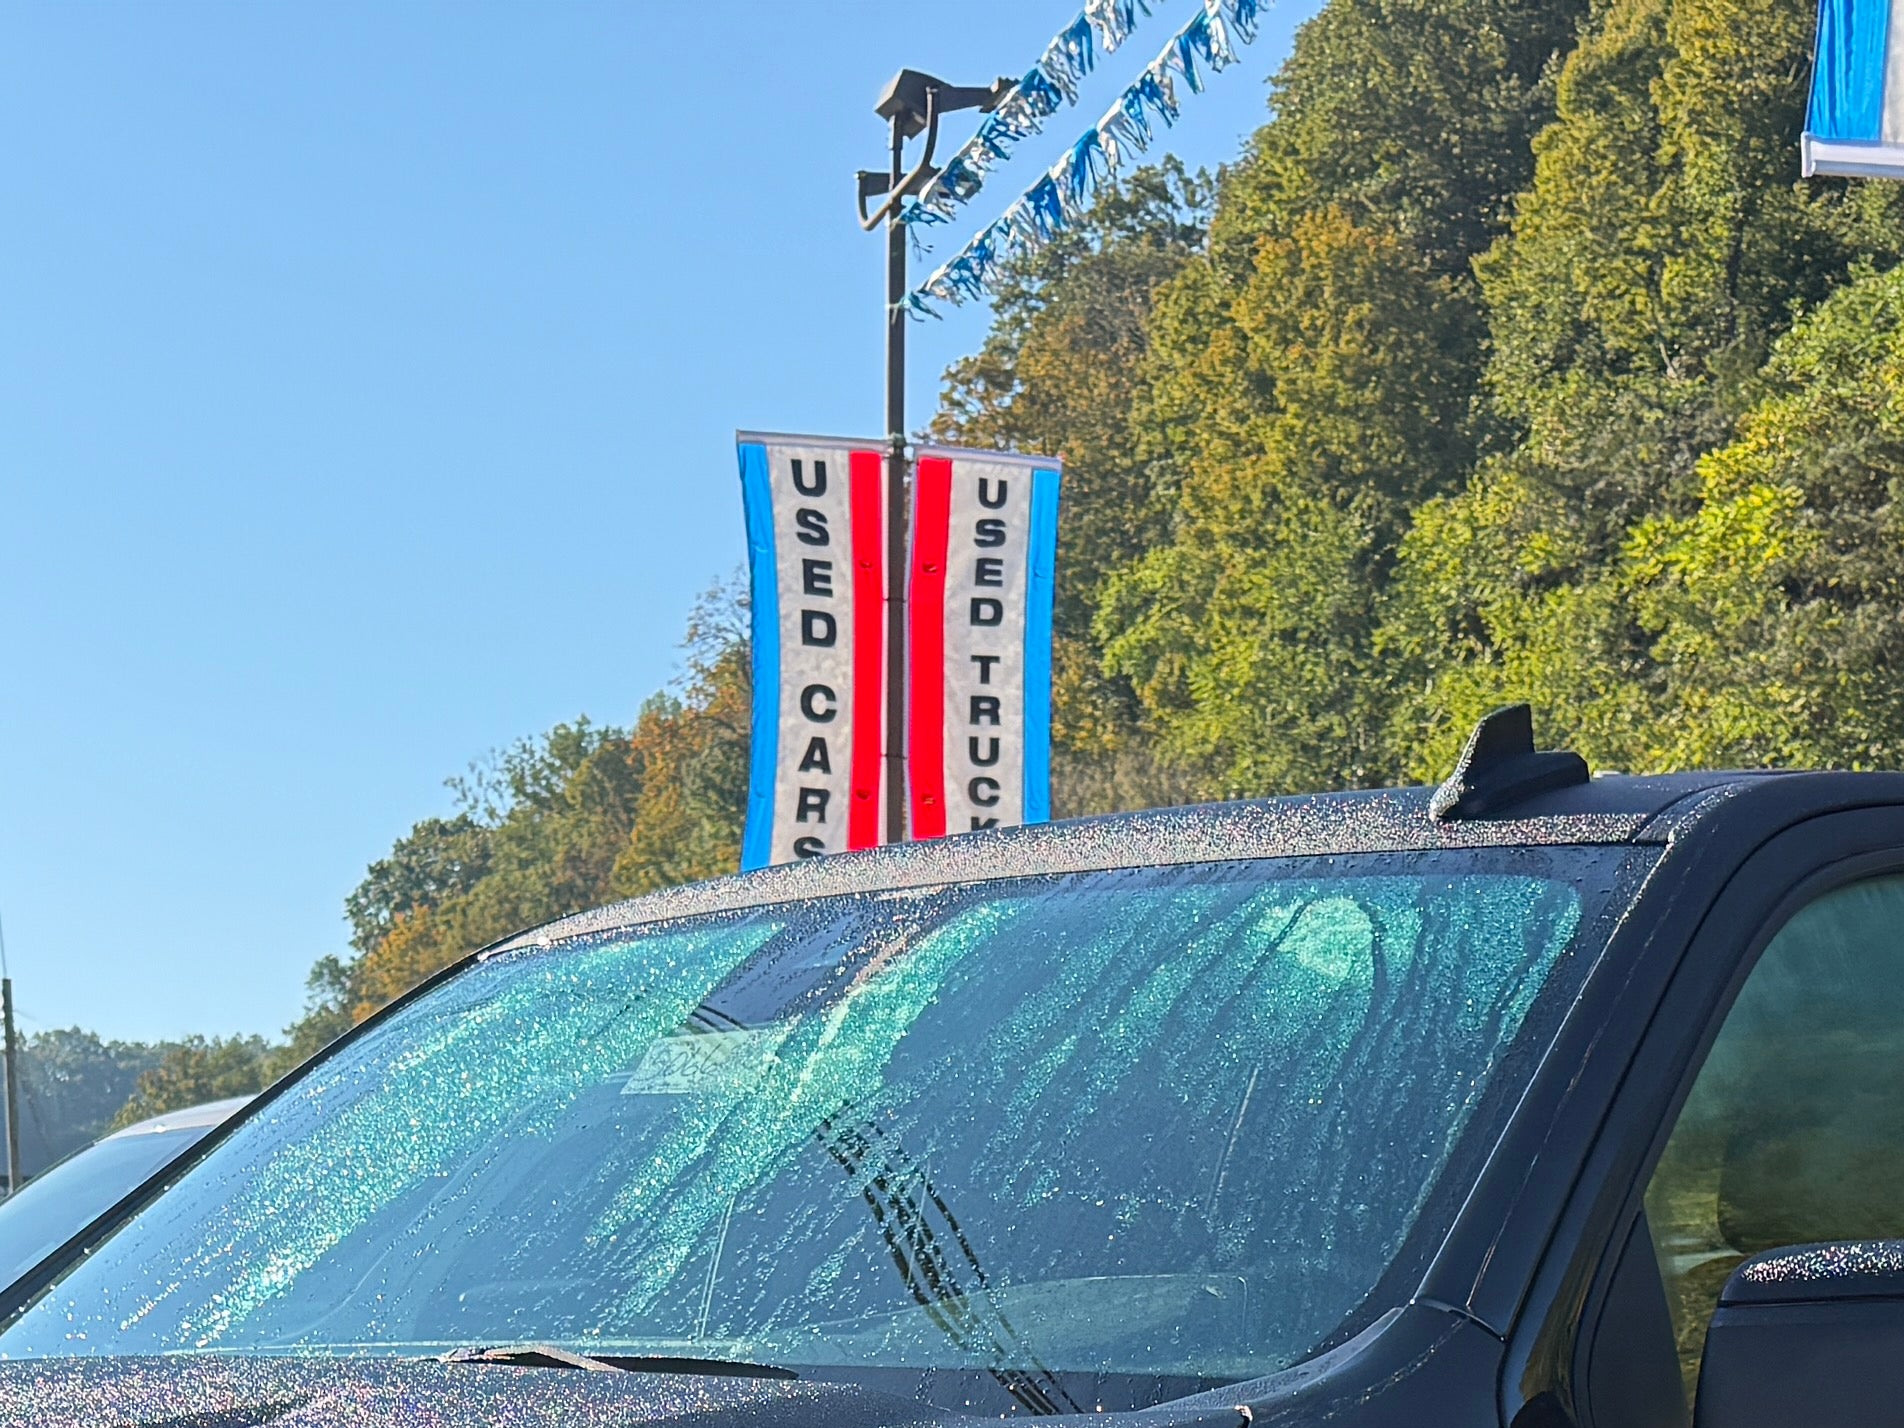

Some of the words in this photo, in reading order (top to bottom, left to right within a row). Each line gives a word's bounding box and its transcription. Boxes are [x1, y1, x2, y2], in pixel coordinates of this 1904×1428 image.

[791, 459, 837, 648] USED
[969, 477, 1008, 627] USED
[793, 684, 838, 858] CARS
